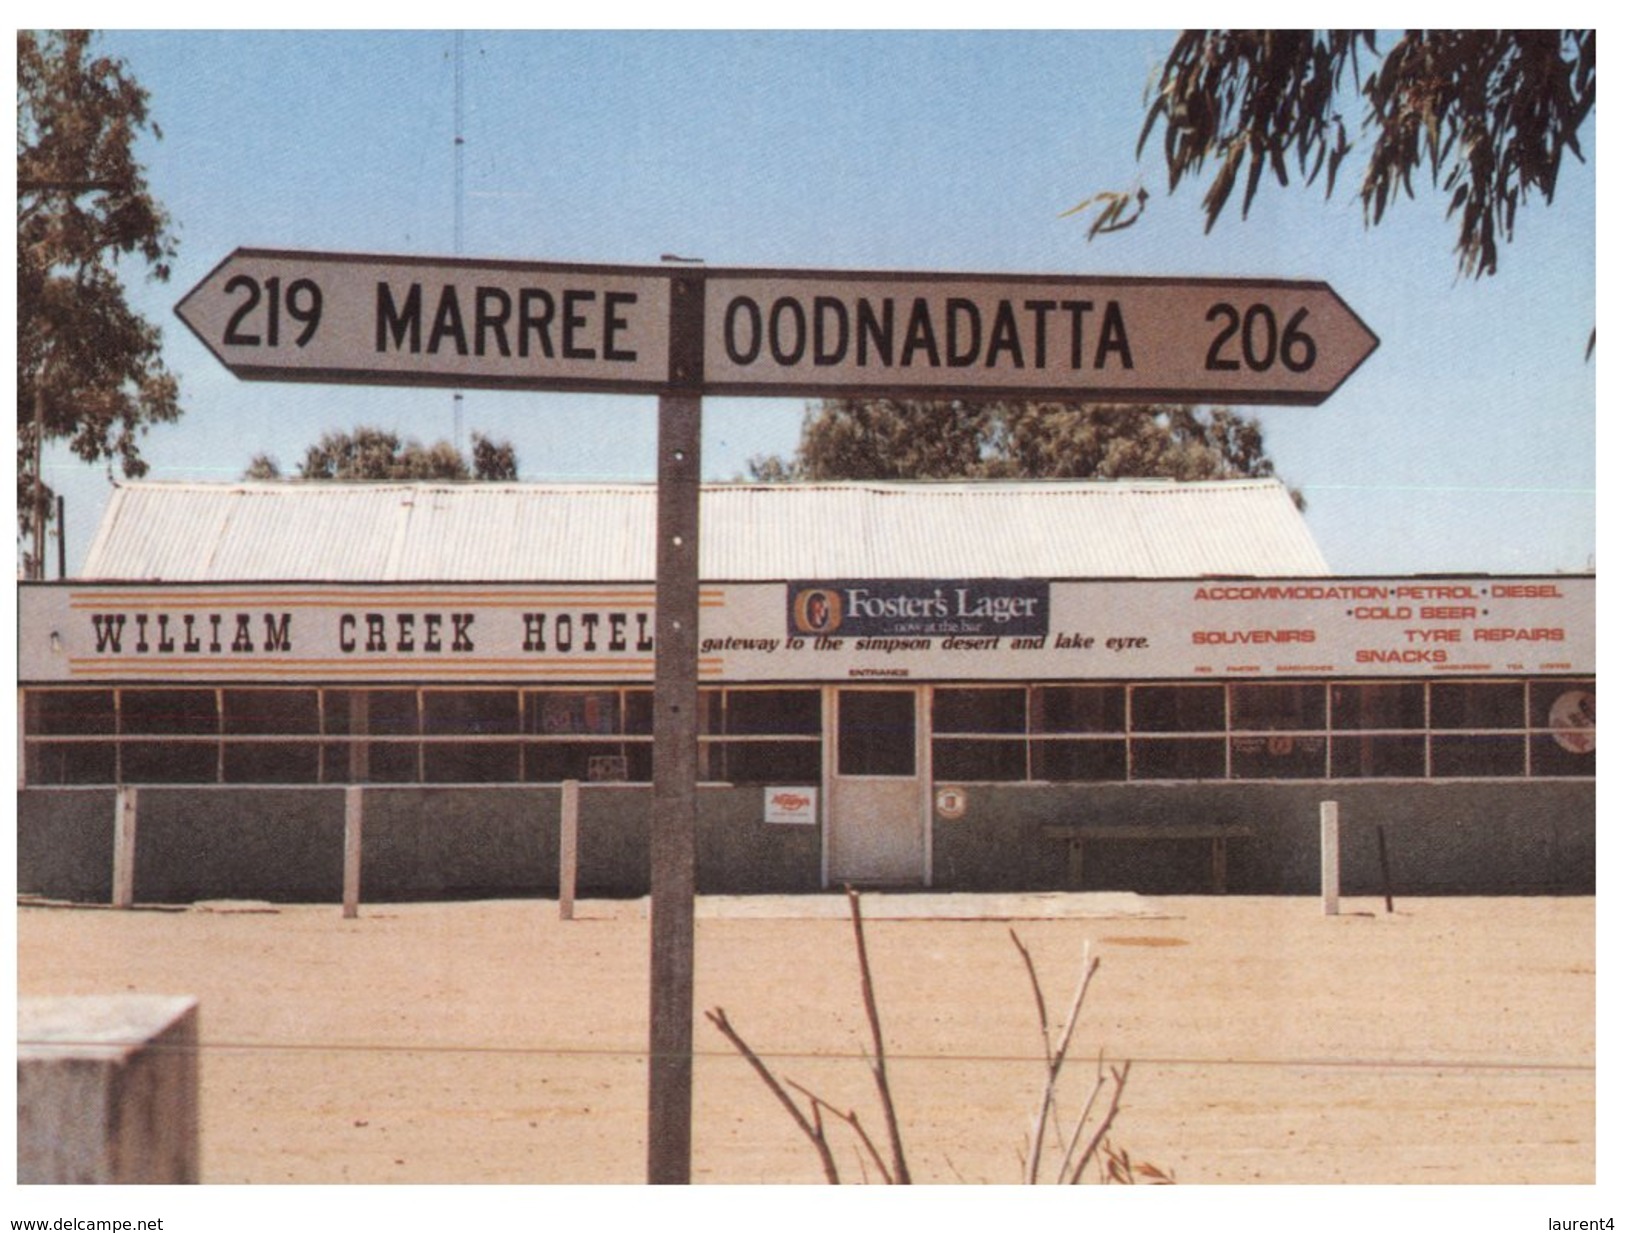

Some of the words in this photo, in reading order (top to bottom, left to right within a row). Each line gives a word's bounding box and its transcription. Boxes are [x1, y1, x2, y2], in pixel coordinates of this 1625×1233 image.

[223, 275, 323, 348] 219
[375, 281, 638, 362] MARREE
[724, 295, 1134, 370] OODNADATTA
[1204, 302, 1318, 373] 206
[1194, 586, 1389, 600] ACCOMMODATION
[1396, 585, 1479, 599] PETROL
[1491, 585, 1563, 599] DIESEL
[845, 588, 948, 618] Foster's
[955, 588, 1039, 623] Lager
[1355, 606, 1412, 619] COLD
[1420, 606, 1476, 619] BEER
[91, 613, 292, 653] WILLIAM
[339, 613, 474, 653] CREEK
[522, 612, 654, 652] HOTEL
[1191, 629, 1316, 644] SOUVENIRS
[1404, 628, 1461, 642] TYRE
[1473, 628, 1565, 642] REPAIRS
[700, 636, 780, 654] gateway
[785, 635, 805, 650] to
[813, 634, 843, 651] the
[855, 634, 932, 653] simpson
[941, 633, 999, 651] desert
[1010, 632, 1046, 651] and
[1054, 632, 1095, 649] lake
[1105, 635, 1150, 652] eyre.
[1355, 649, 1448, 663] SNACKS
[848, 668, 910, 677] ENTRANCE
